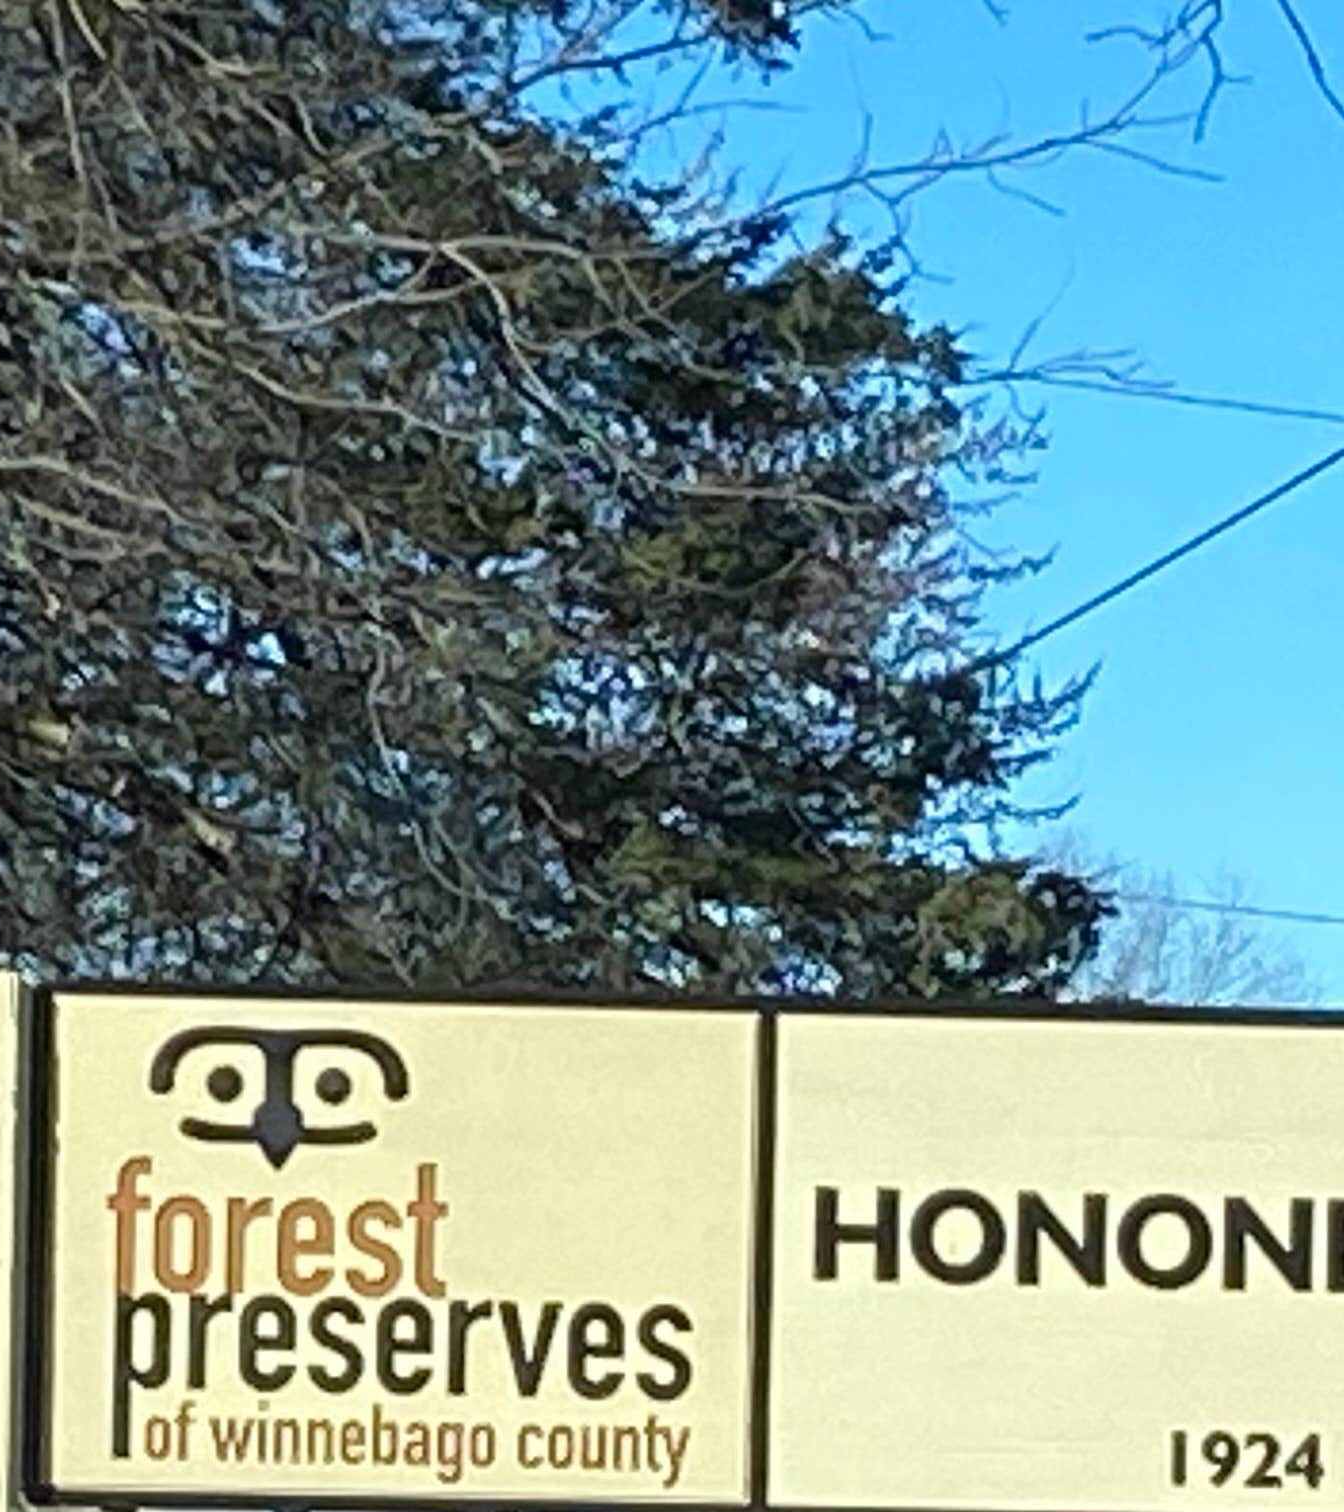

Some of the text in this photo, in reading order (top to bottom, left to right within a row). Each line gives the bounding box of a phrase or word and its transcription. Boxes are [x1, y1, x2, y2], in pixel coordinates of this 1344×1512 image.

[108, 1156, 448, 1297] forest
[112, 1290, 695, 1459] preserves
[143, 1399, 691, 1488] of winnebago county
[1169, 1430, 1325, 1490] 1924
